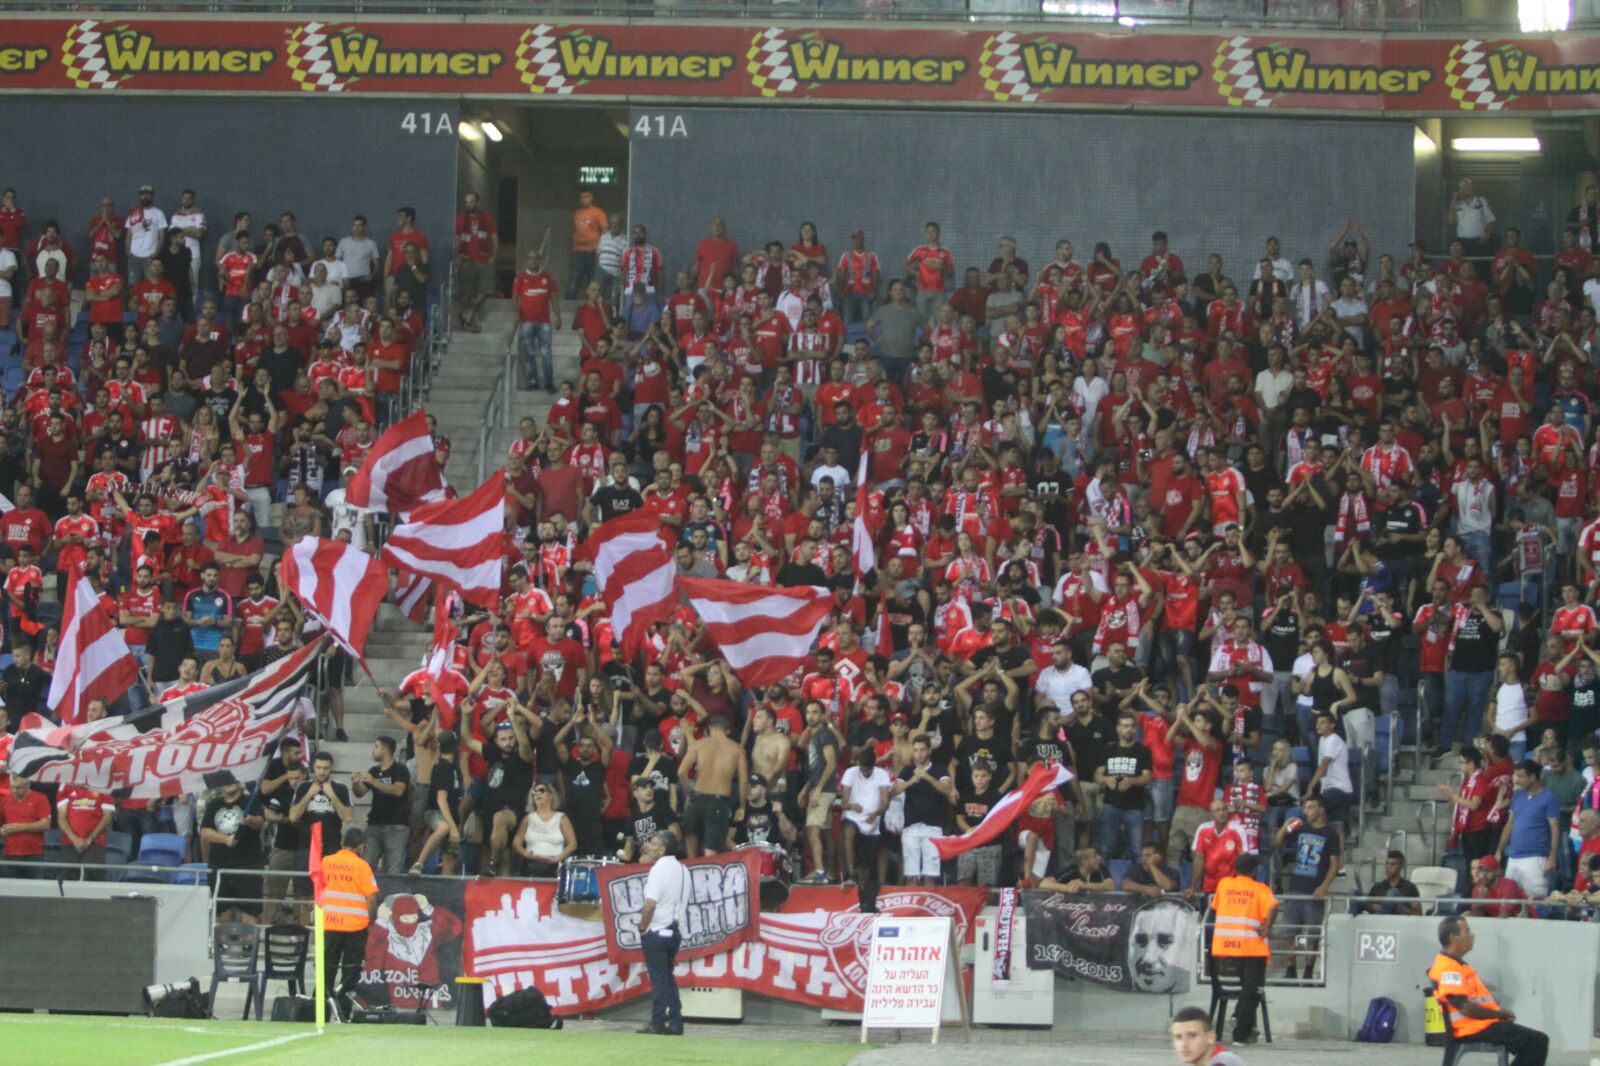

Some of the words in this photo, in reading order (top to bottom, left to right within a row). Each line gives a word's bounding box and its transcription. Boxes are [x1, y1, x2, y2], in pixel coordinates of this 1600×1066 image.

[104, 34, 273, 72] Winner
[330, 36, 501, 75] Winner
[559, 39, 733, 78] Winner
[791, 43, 964, 82] Winner
[1024, 46, 1198, 87] Winner
[1257, 50, 1432, 91] Winner
[401, 112, 453, 135] 41A
[635, 115, 688, 137] 41A
[128, 737, 264, 784] TOUR
[611, 864, 747, 914] URA
[617, 894, 747, 948] SUTH
[877, 944, 941, 961] אזהרה!
[1360, 934, 1395, 959] P-32
[885, 969, 896, 980] על
[899, 968, 929, 980] העליה
